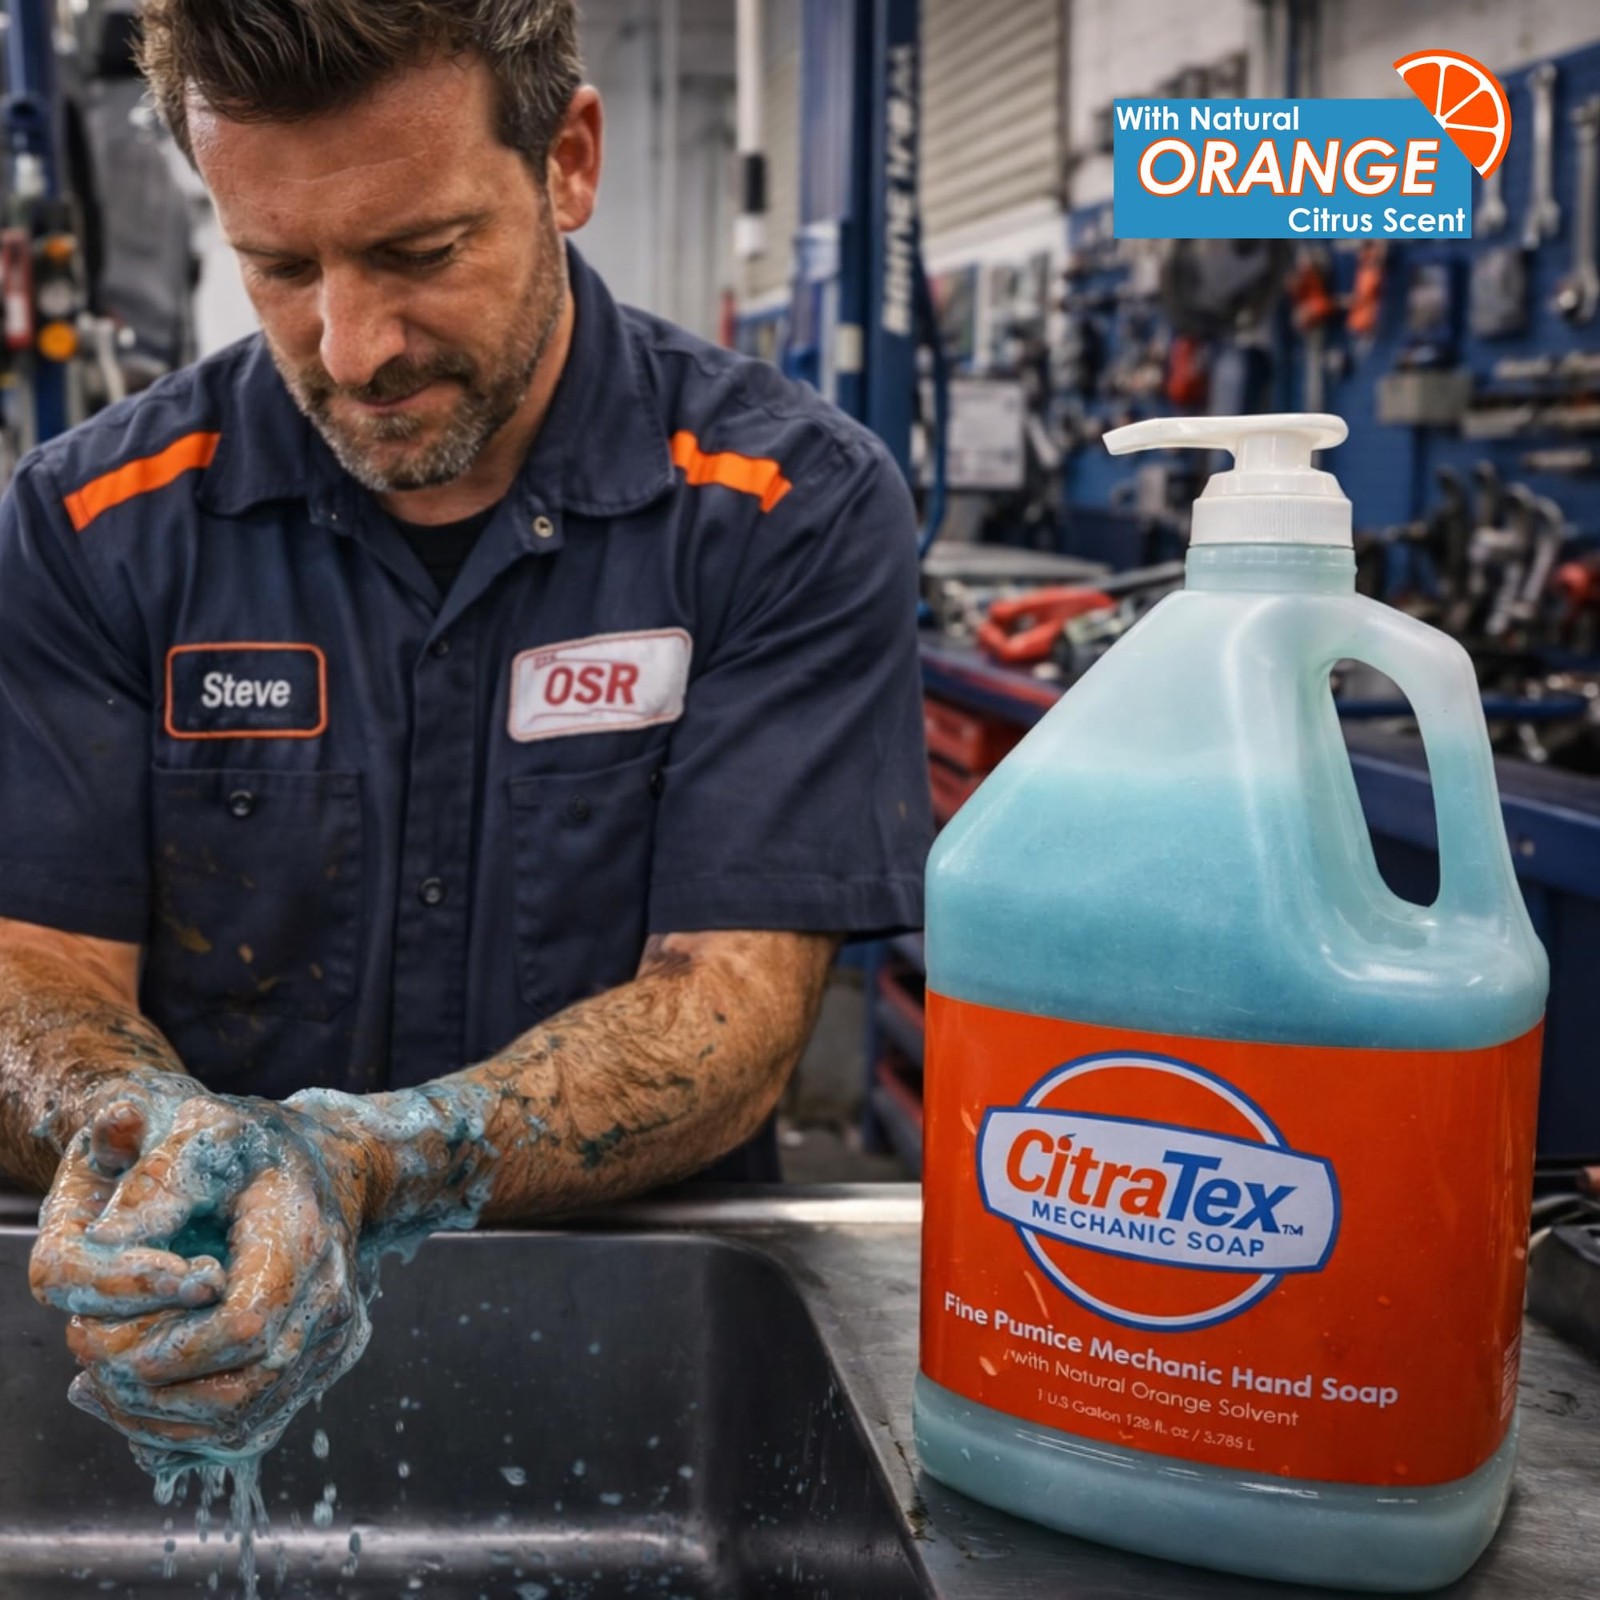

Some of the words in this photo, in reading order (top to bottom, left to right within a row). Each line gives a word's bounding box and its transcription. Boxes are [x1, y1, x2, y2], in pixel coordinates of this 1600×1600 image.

[202, 671, 292, 708] Steve
[544, 661, 639, 706] OSR
[1032, 1200, 1176, 1245] MECHANIC
[1186, 1231, 1265, 1257] SOAP
[944, 1291, 989, 1325] Fine
[994, 1310, 1083, 1352] Pumice
[1089, 1337, 1223, 1386] Mechanic
[1231, 1366, 1312, 1398] Hand
[1321, 1377, 1398, 1408] Soap
[1055, 1361, 1126, 1394] Natural
[1131, 1381, 1212, 1415] Orange
[1218, 1399, 1299, 1426] Solvent
[1247, 1439, 1255, 1451] L
